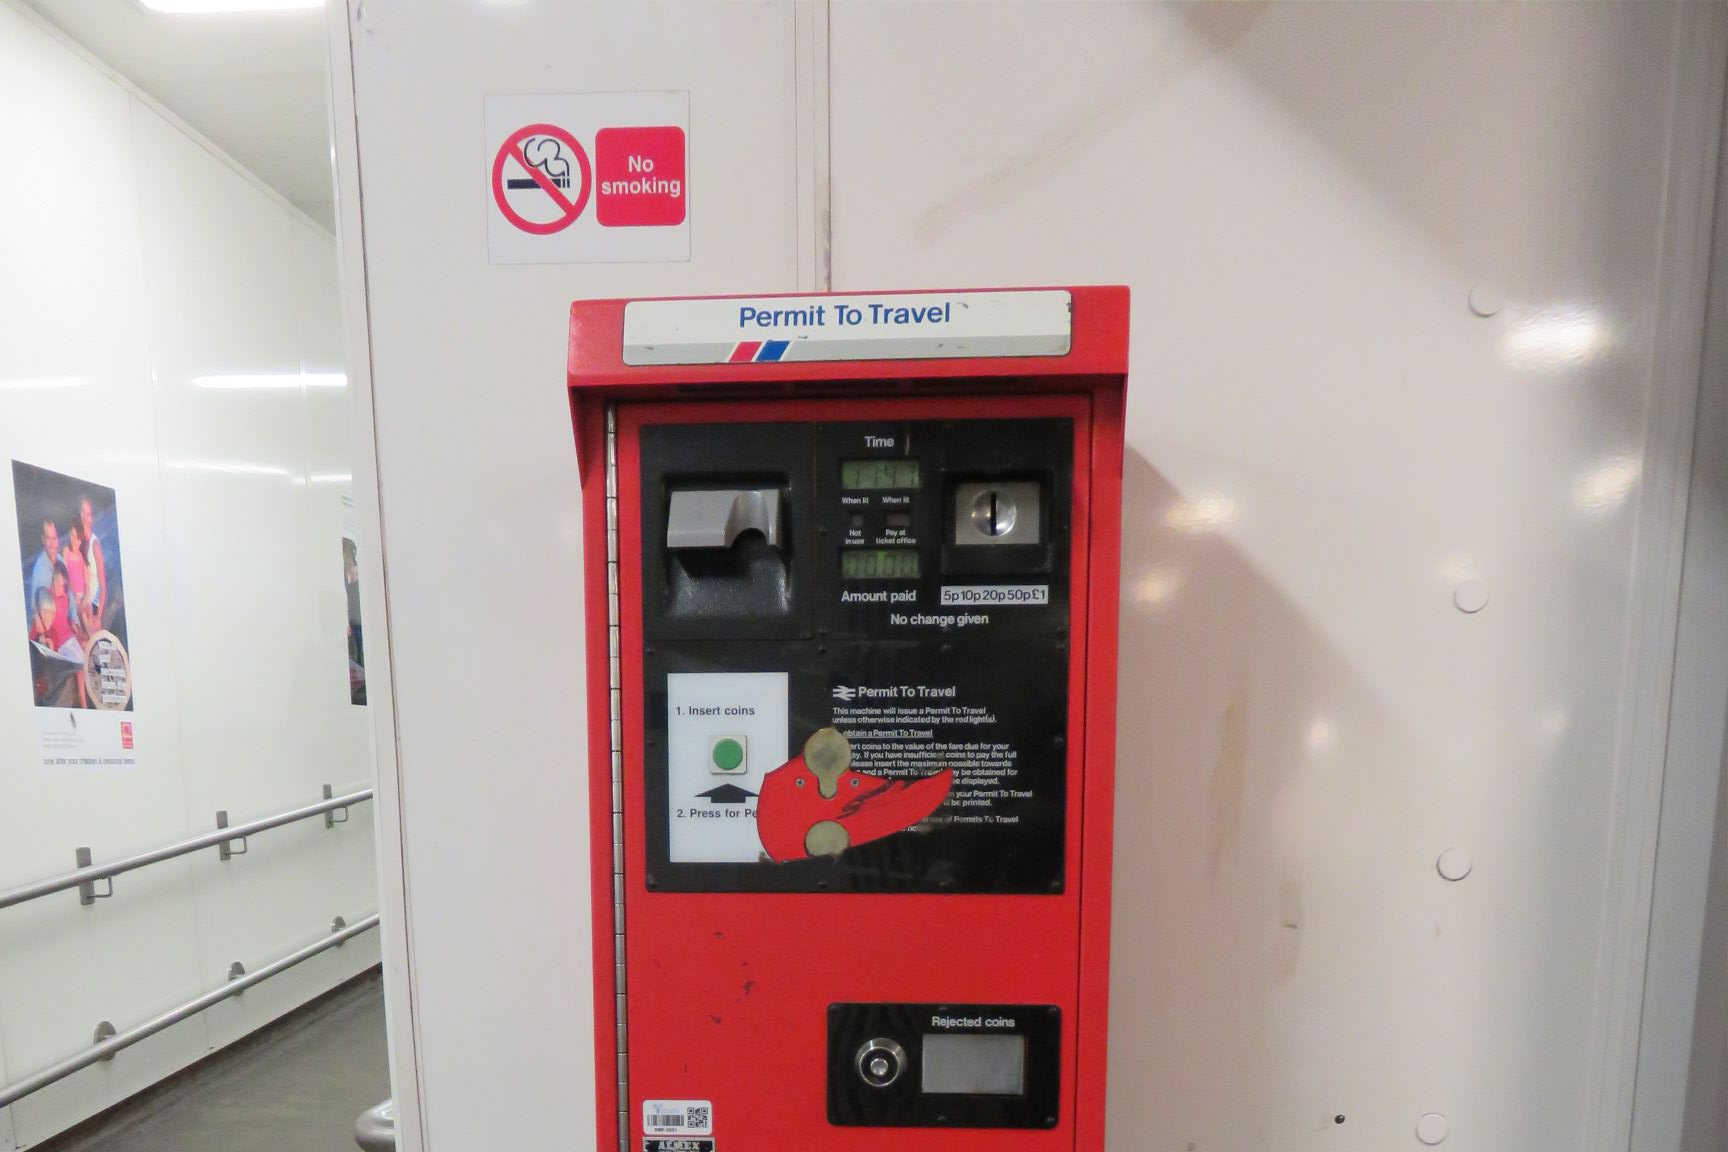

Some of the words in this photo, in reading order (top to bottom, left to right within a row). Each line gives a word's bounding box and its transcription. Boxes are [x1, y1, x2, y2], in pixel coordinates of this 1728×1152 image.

[628, 155, 654, 172] No
[601, 176, 681, 198] smoking
[740, 304, 825, 328] Permit
[834, 304, 863, 326] To
[869, 302, 950, 325] Travel
[864, 436, 895, 448] Time
[882, 496, 902, 504] When
[885, 529, 898, 537] Pay
[841, 590, 888, 602] Amount
[890, 590, 917, 604] paid
[891, 614, 908, 625] No
[910, 614, 956, 627] change
[957, 613, 989, 626] given
[858, 686, 898, 698] Permit
[899, 686, 915, 698] To
[917, 686, 956, 698] Travel
[676, 706, 686, 715] 1.
[688, 706, 721, 716] Insert
[724, 705, 756, 716] coins
[832, 707, 849, 715] This
[850, 707, 882, 715] machine
[883, 707, 897, 715] will
[898, 707, 918, 715] issue
[925, 707, 950, 715] Permit
[951, 706, 962, 715] To
[962, 706, 986, 715] Travel
[832, 716, 856, 724] unless
[857, 716, 894, 724] otherwise
[896, 715, 932, 724] indicated
[873, 730, 898, 738] Permit
[909, 730, 934, 738] Travel
[992, 744, 1010, 752] your
[973, 790, 998, 798] Permit
[1010, 790, 1032, 798] Travel
[676, 809, 686, 818] 2.
[689, 809, 721, 818] Press
[725, 809, 740, 818] for
[994, 816, 1020, 824] Travel
[932, 1016, 982, 1029] Rejected
[984, 1017, 1016, 1028] coins
